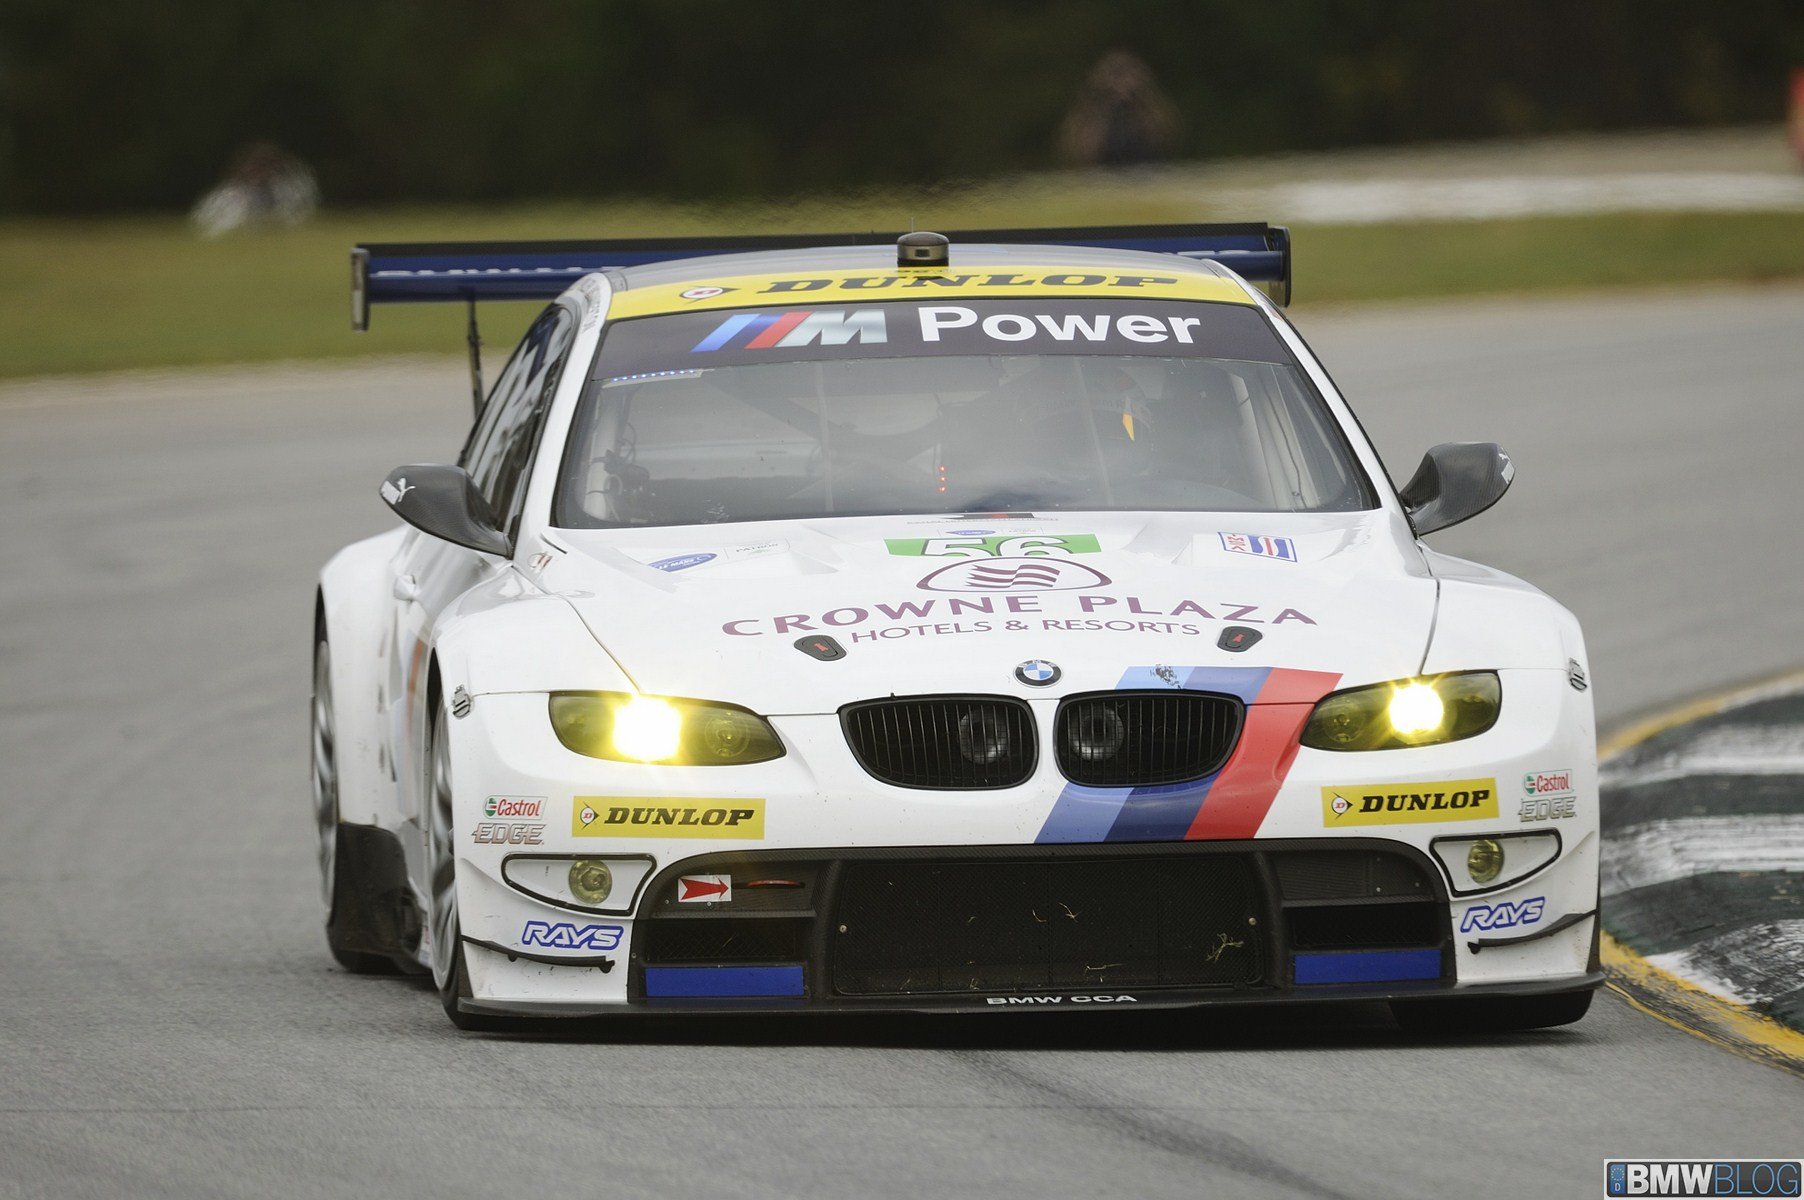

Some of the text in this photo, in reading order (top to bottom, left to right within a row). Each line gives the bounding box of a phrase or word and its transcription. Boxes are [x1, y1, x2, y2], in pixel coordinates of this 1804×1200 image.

[757, 274, 1177, 294] DUNLOP
[918, 306, 1201, 343] Power
[920, 537, 1074, 556] 56
[722, 595, 1318, 636] CROWNE PLAZA
[851, 619, 1200, 643] HOTELS & RESORTS
[1536, 773, 1570, 793] Castrol
[497, 798, 542, 817] Castrol
[1359, 789, 1490, 813] DUNLOP
[1518, 796, 1576, 823] EDGE
[604, 807, 754, 826] DUNLOP
[472, 822, 547, 845] EDGE
[1460, 896, 1546, 933] RAYS
[522, 920, 624, 951] RAYS
[986, 995, 1138, 1005] BMW CCA
